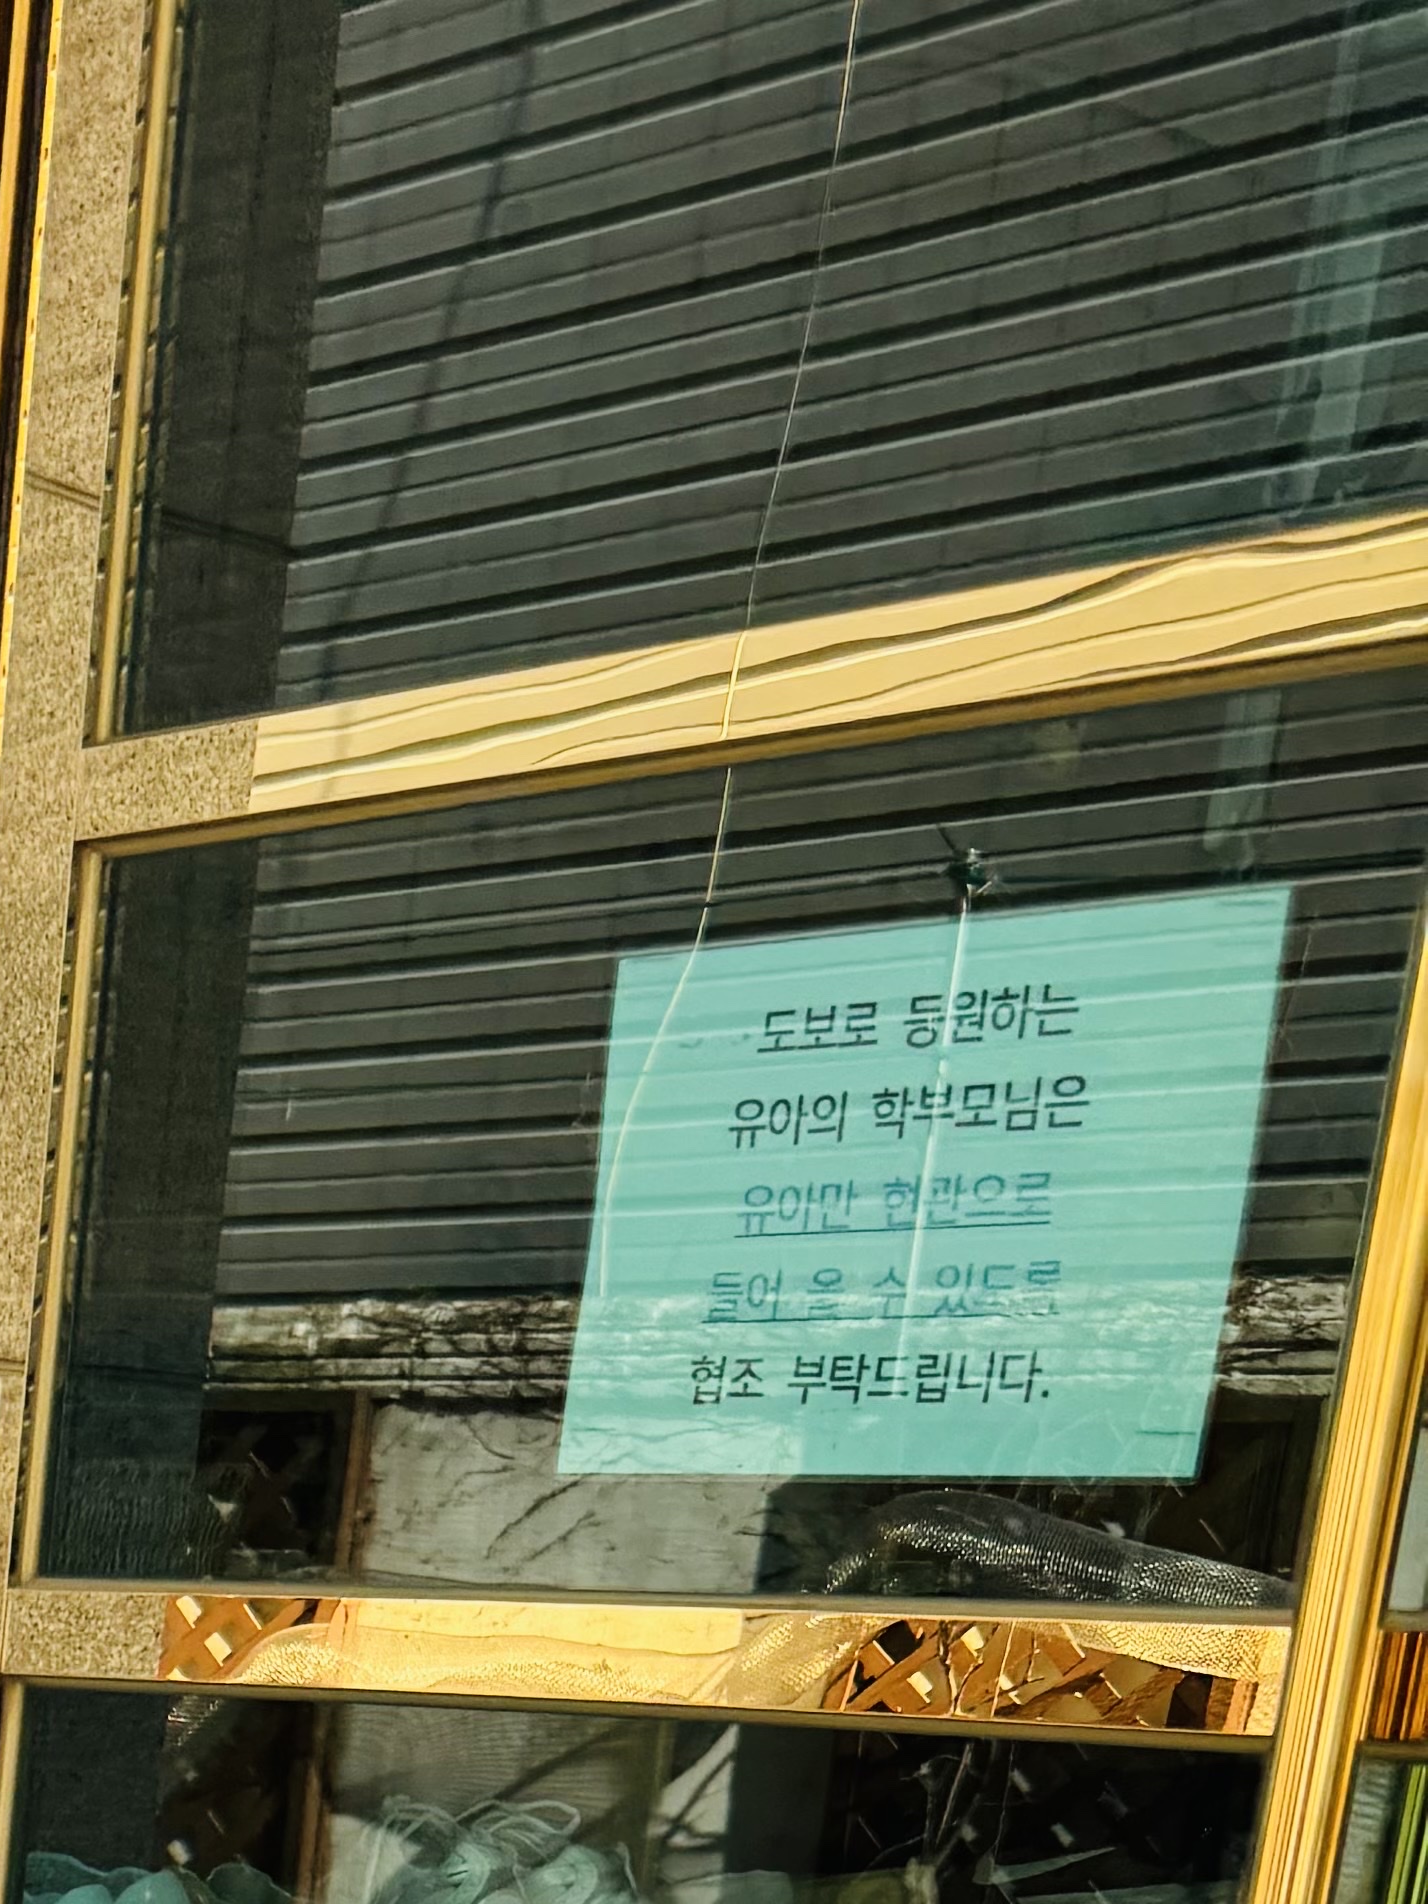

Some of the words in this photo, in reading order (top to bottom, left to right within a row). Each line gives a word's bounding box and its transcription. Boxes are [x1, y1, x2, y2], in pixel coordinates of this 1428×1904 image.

[756, 1001, 878, 1053] 도보로
[902, 983, 1080, 1049] 등원하는
[727, 1090, 849, 1150] 유아의
[872, 1074, 1091, 1140] 학부모님은
[736, 1178, 858, 1236] 유아만
[883, 1172, 1052, 1229] 현관으로
[707, 1267, 783, 1322] 들어
[872, 1266, 908, 1317] 수
[690, 1354, 765, 1405] 협조
[787, 1350, 1050, 1405] 부탁드립니다.
